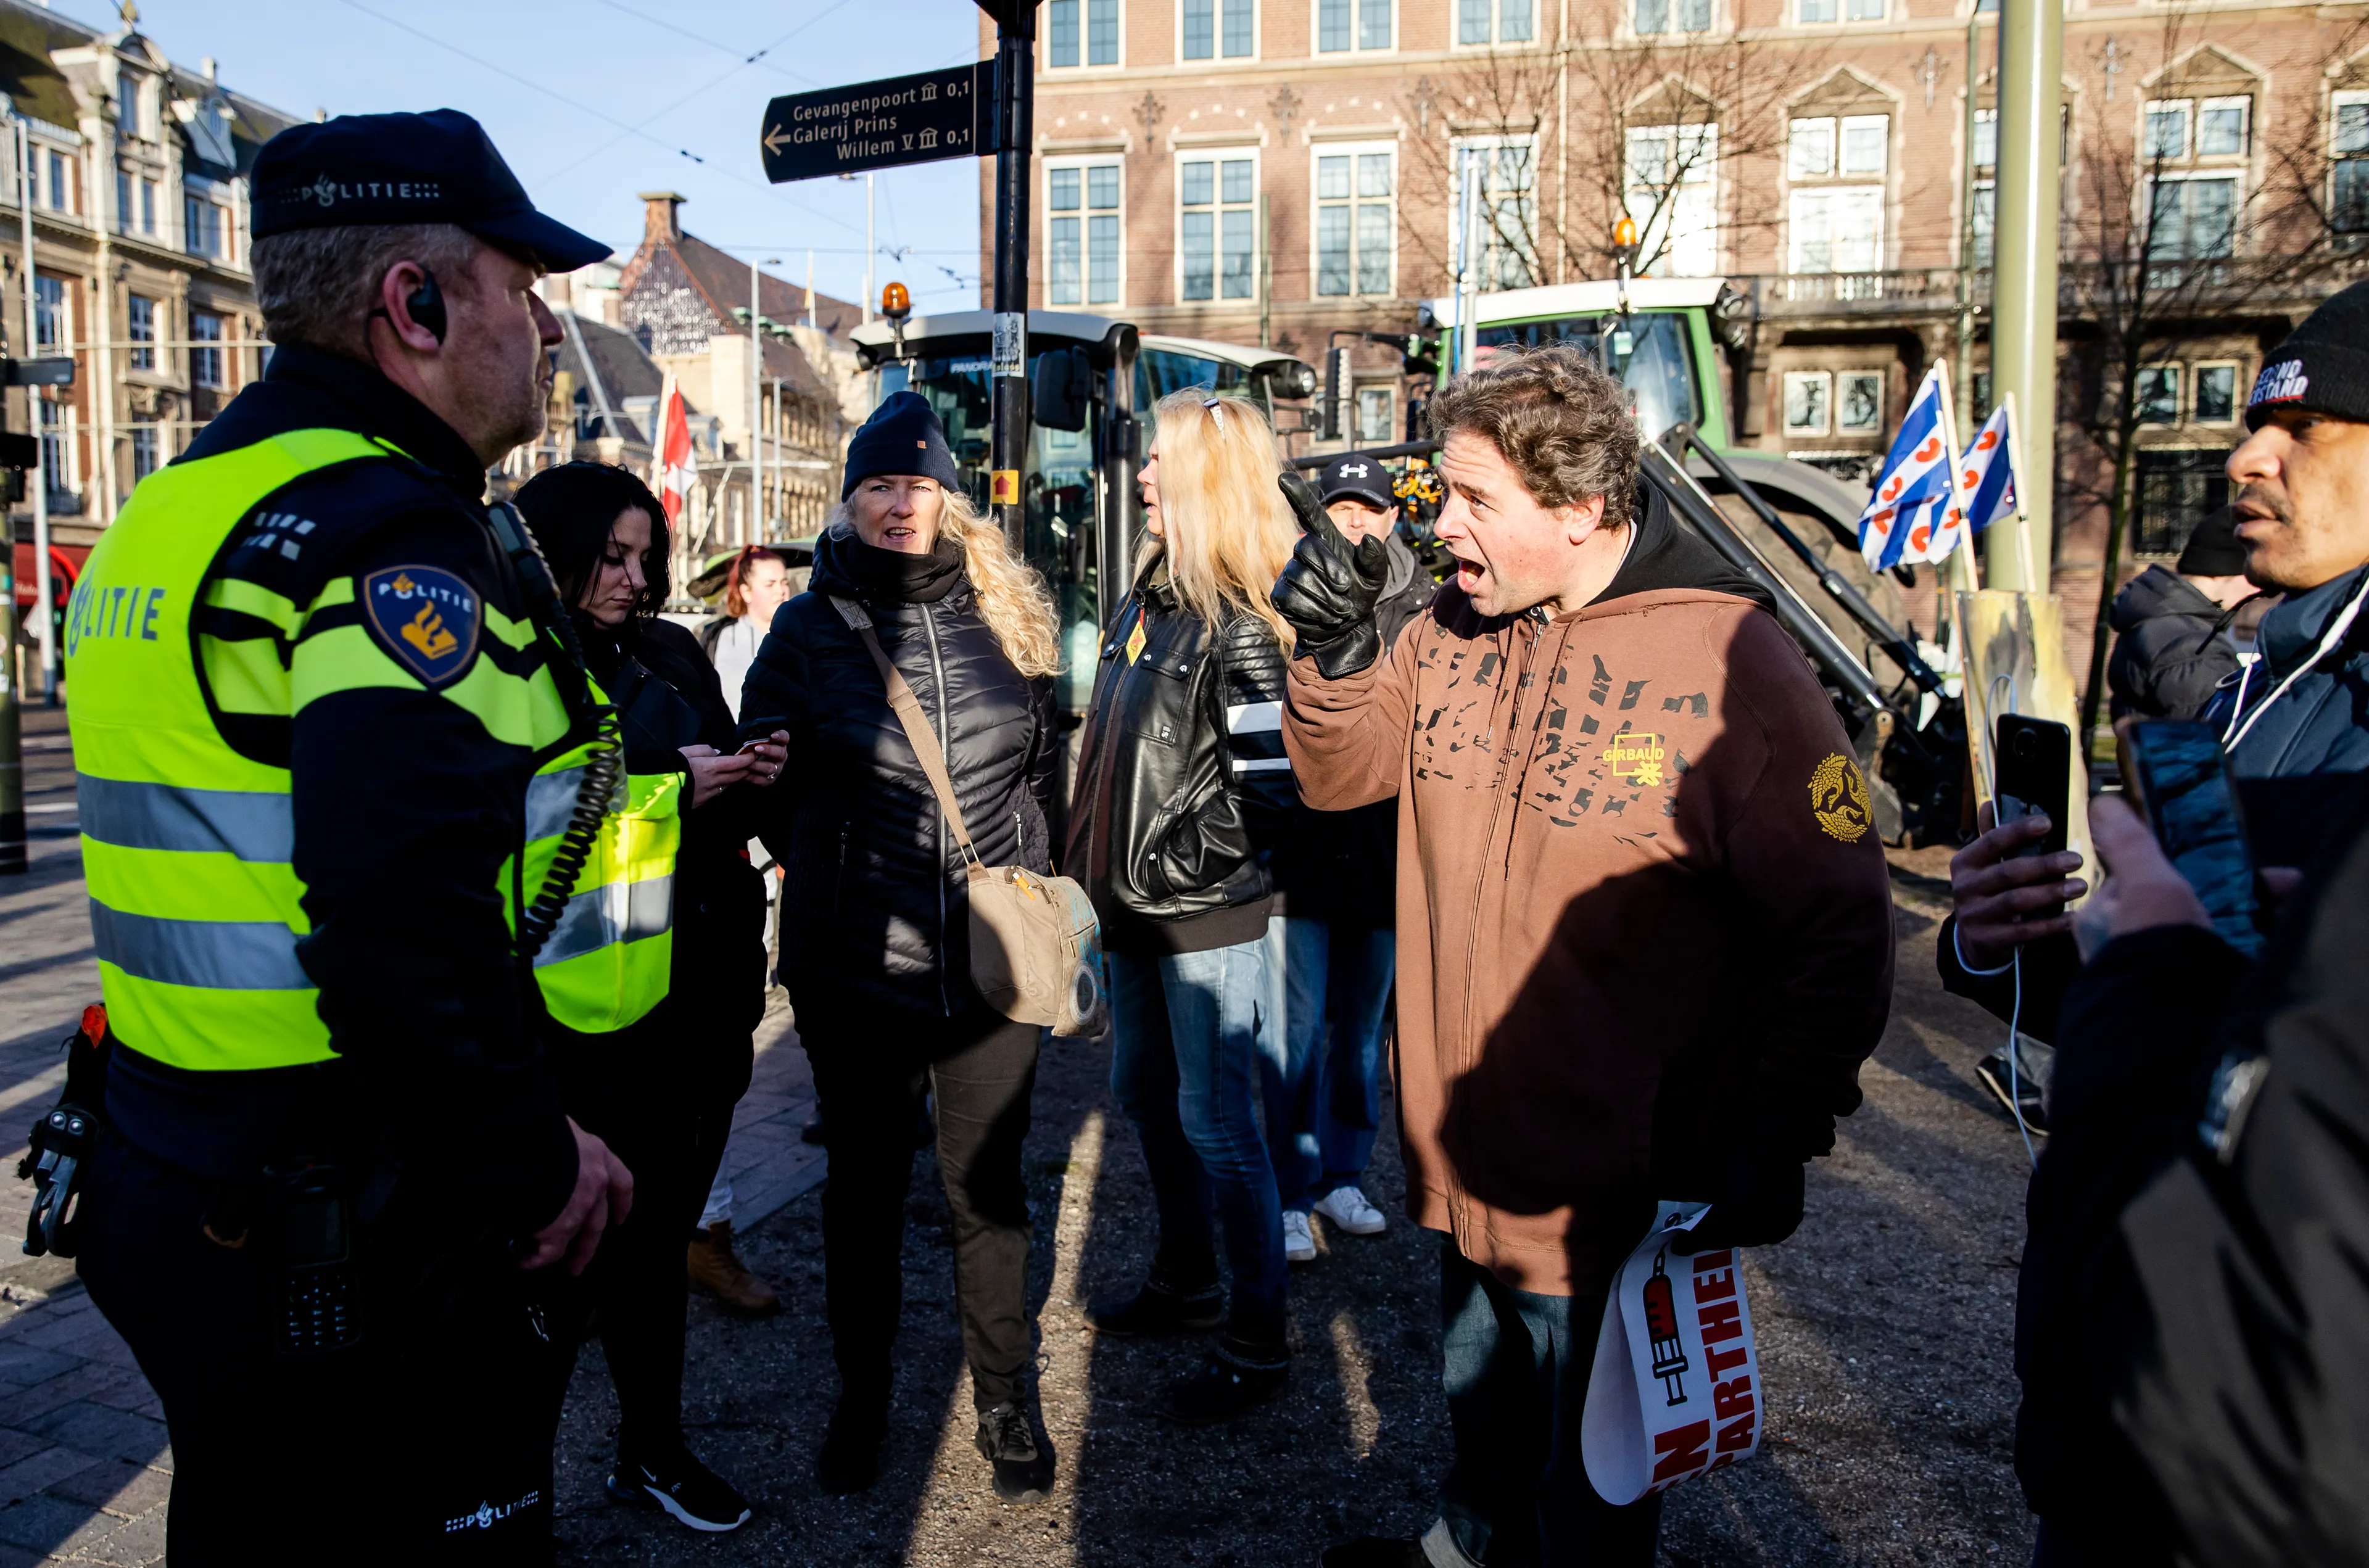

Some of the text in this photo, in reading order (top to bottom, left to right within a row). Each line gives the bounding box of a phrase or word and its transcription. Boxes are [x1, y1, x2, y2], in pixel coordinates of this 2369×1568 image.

[793, 81, 969, 122] Gevangenpoort 0,1
[793, 115, 897, 144] Galerij Prins
[837, 128, 969, 160] Willem V 0,1
[378, 582, 471, 613] POLITIE
[1602, 748, 1665, 762] GIRBAUD
[466, 1496, 527, 1528] POLITIE
